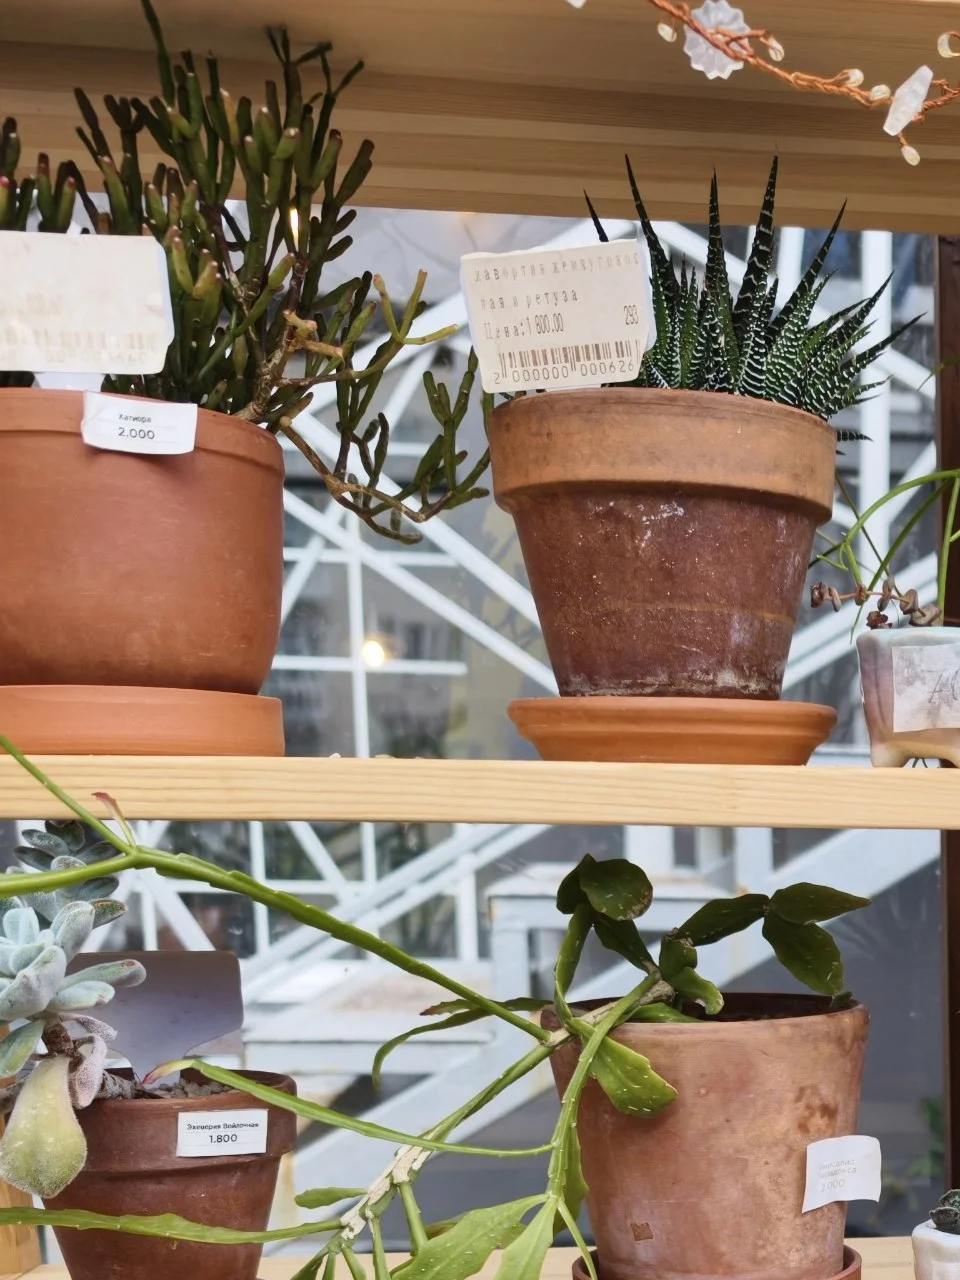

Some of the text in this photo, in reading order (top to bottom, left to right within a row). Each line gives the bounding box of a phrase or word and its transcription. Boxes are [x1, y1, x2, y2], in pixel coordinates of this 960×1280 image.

[526, 289, 578, 308] ретуза
[623, 304, 639, 325] 293
[512, 365, 569, 383] 000000
[580, 360, 634, 377] 000626
[118, 427, 155, 440] 2.000
[186, 1122, 259, 1131] Эхеверия Войлочная
[209, 1133, 238, 1143] 1.800
